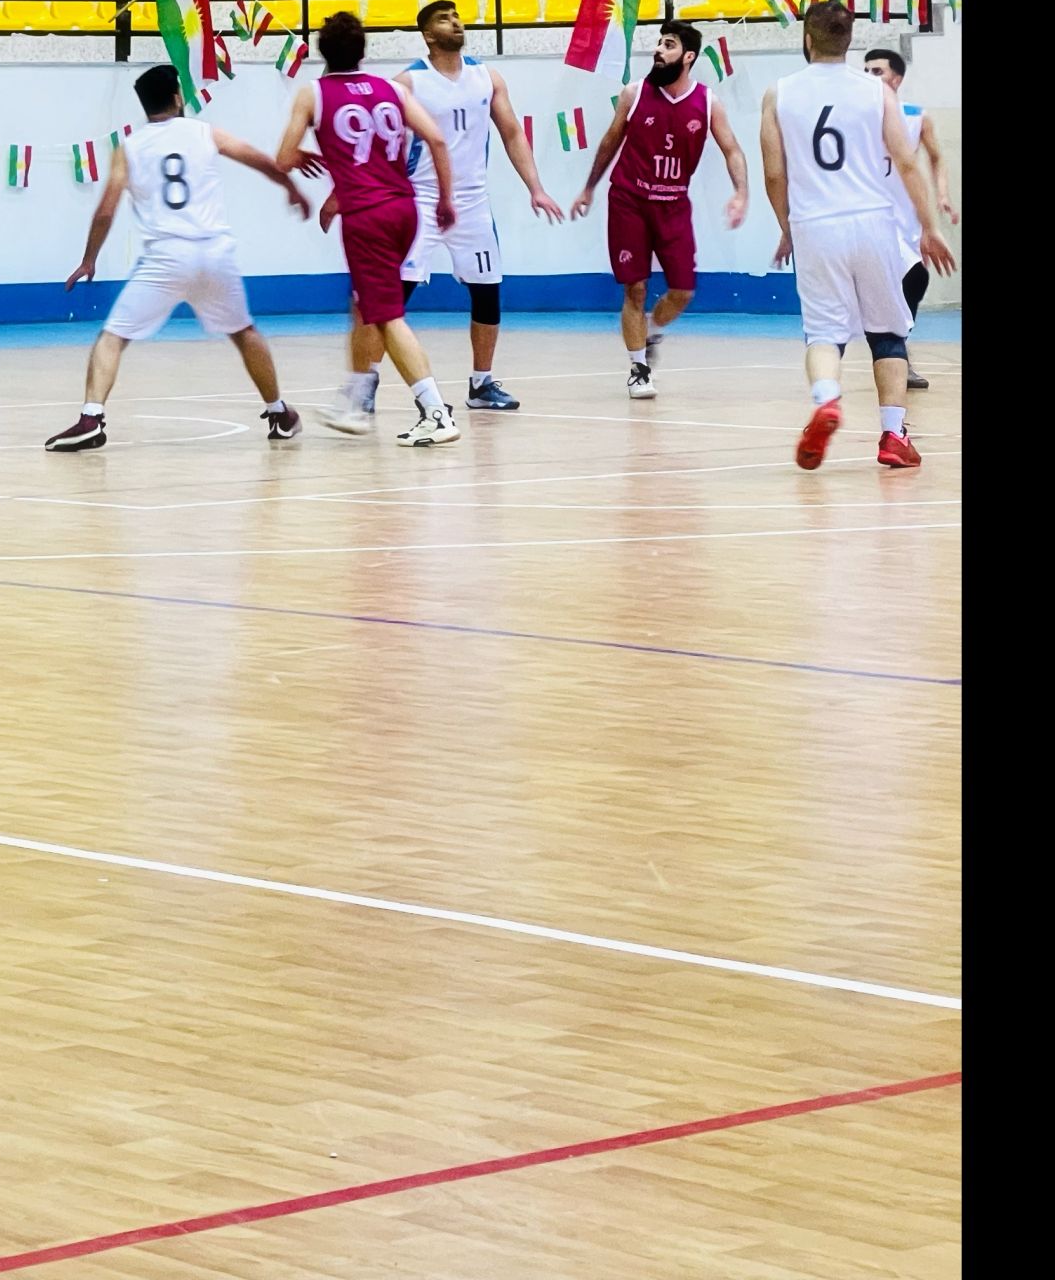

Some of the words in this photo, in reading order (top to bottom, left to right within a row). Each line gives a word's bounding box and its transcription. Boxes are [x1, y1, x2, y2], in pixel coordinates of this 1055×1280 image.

[453, 108, 466, 131] 11
[333, 102, 404, 165] 99
[664, 133, 675, 151] 5
[812, 105, 845, 172] 6
[653, 154, 682, 180] TIU
[161, 152, 190, 211] 8
[474, 250, 492, 274] 11
